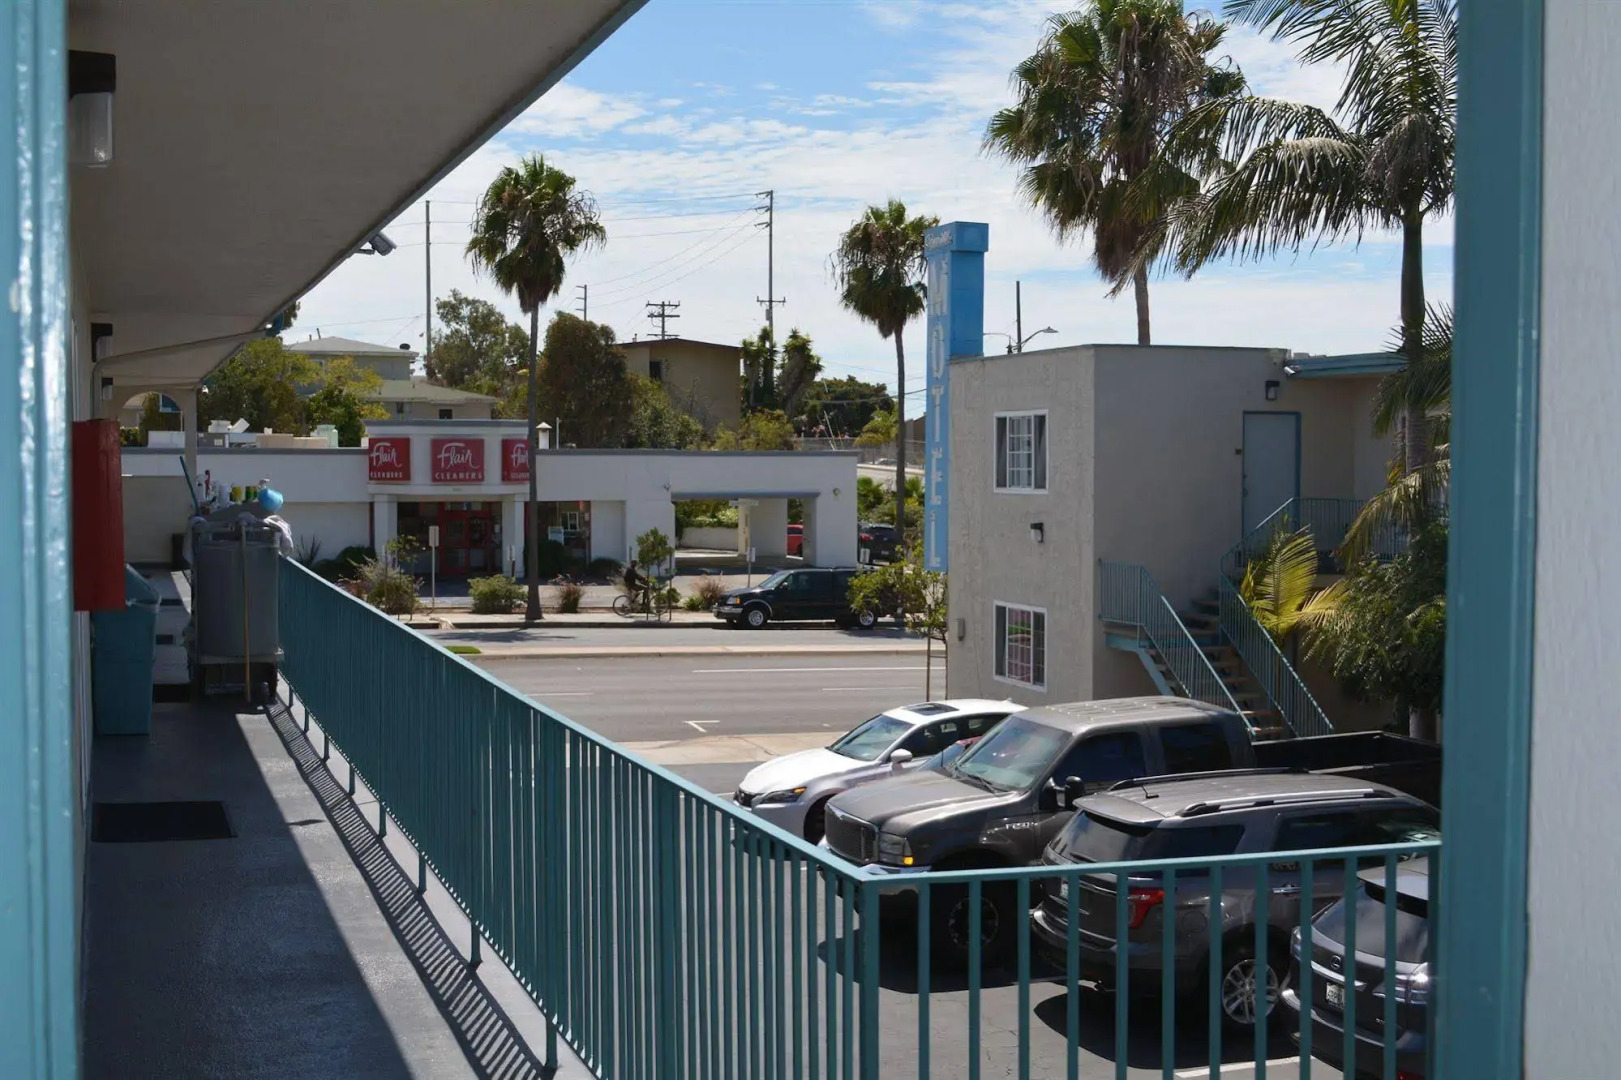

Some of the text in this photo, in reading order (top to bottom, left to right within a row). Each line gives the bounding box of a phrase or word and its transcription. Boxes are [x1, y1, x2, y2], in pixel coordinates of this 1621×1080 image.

[370, 442, 403, 468] Flair
[437, 442, 480, 469] Flair
[370, 471, 403, 479] CLEANERS
[435, 472, 483, 480] CLEANERS
